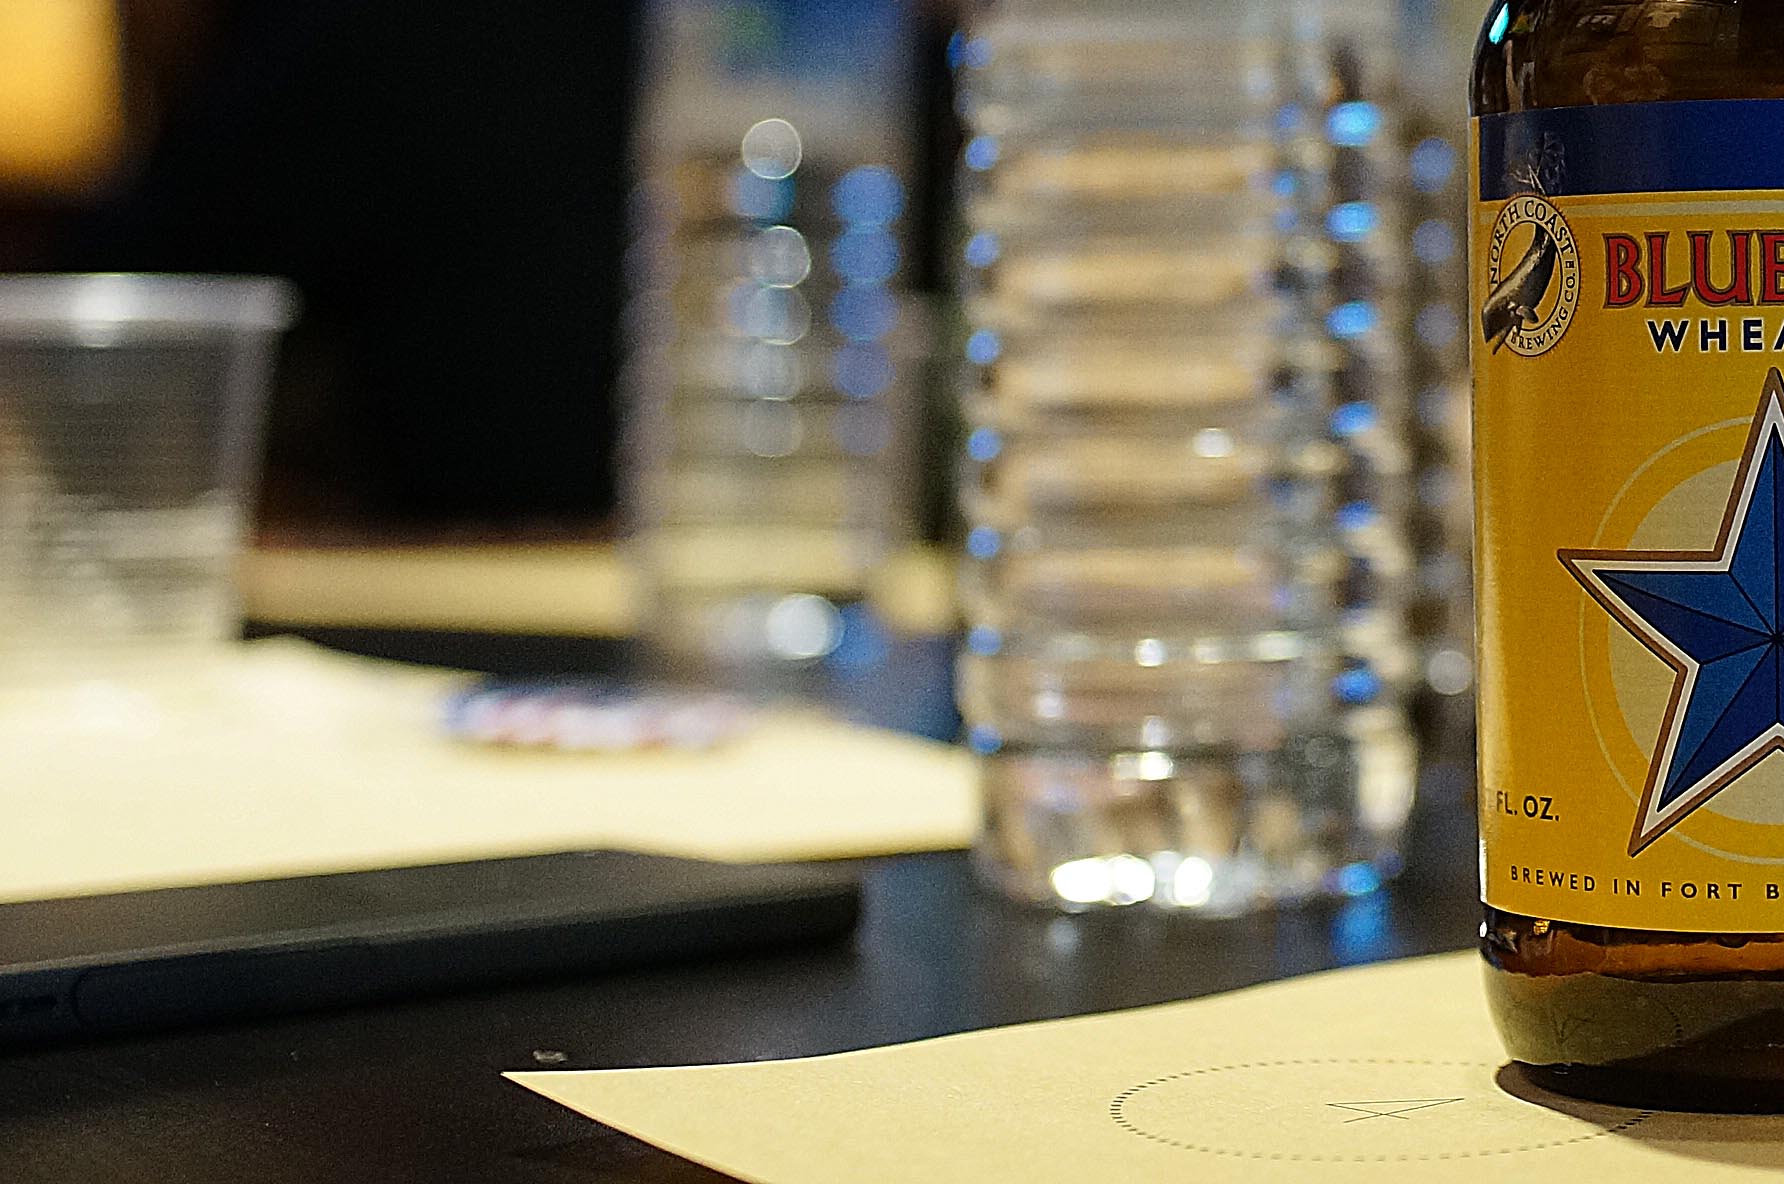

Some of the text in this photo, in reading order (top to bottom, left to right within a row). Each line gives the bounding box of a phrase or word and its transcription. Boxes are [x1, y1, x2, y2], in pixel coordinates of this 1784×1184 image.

[1490, 200, 1574, 285] NORTH COAST
[1510, 306, 1568, 350] BREWING
[1523, 795, 1560, 822] OZ.
[1510, 865, 1596, 892] BREWED
[1612, 878, 1641, 896] IN
[1660, 881, 1743, 899] FORT
